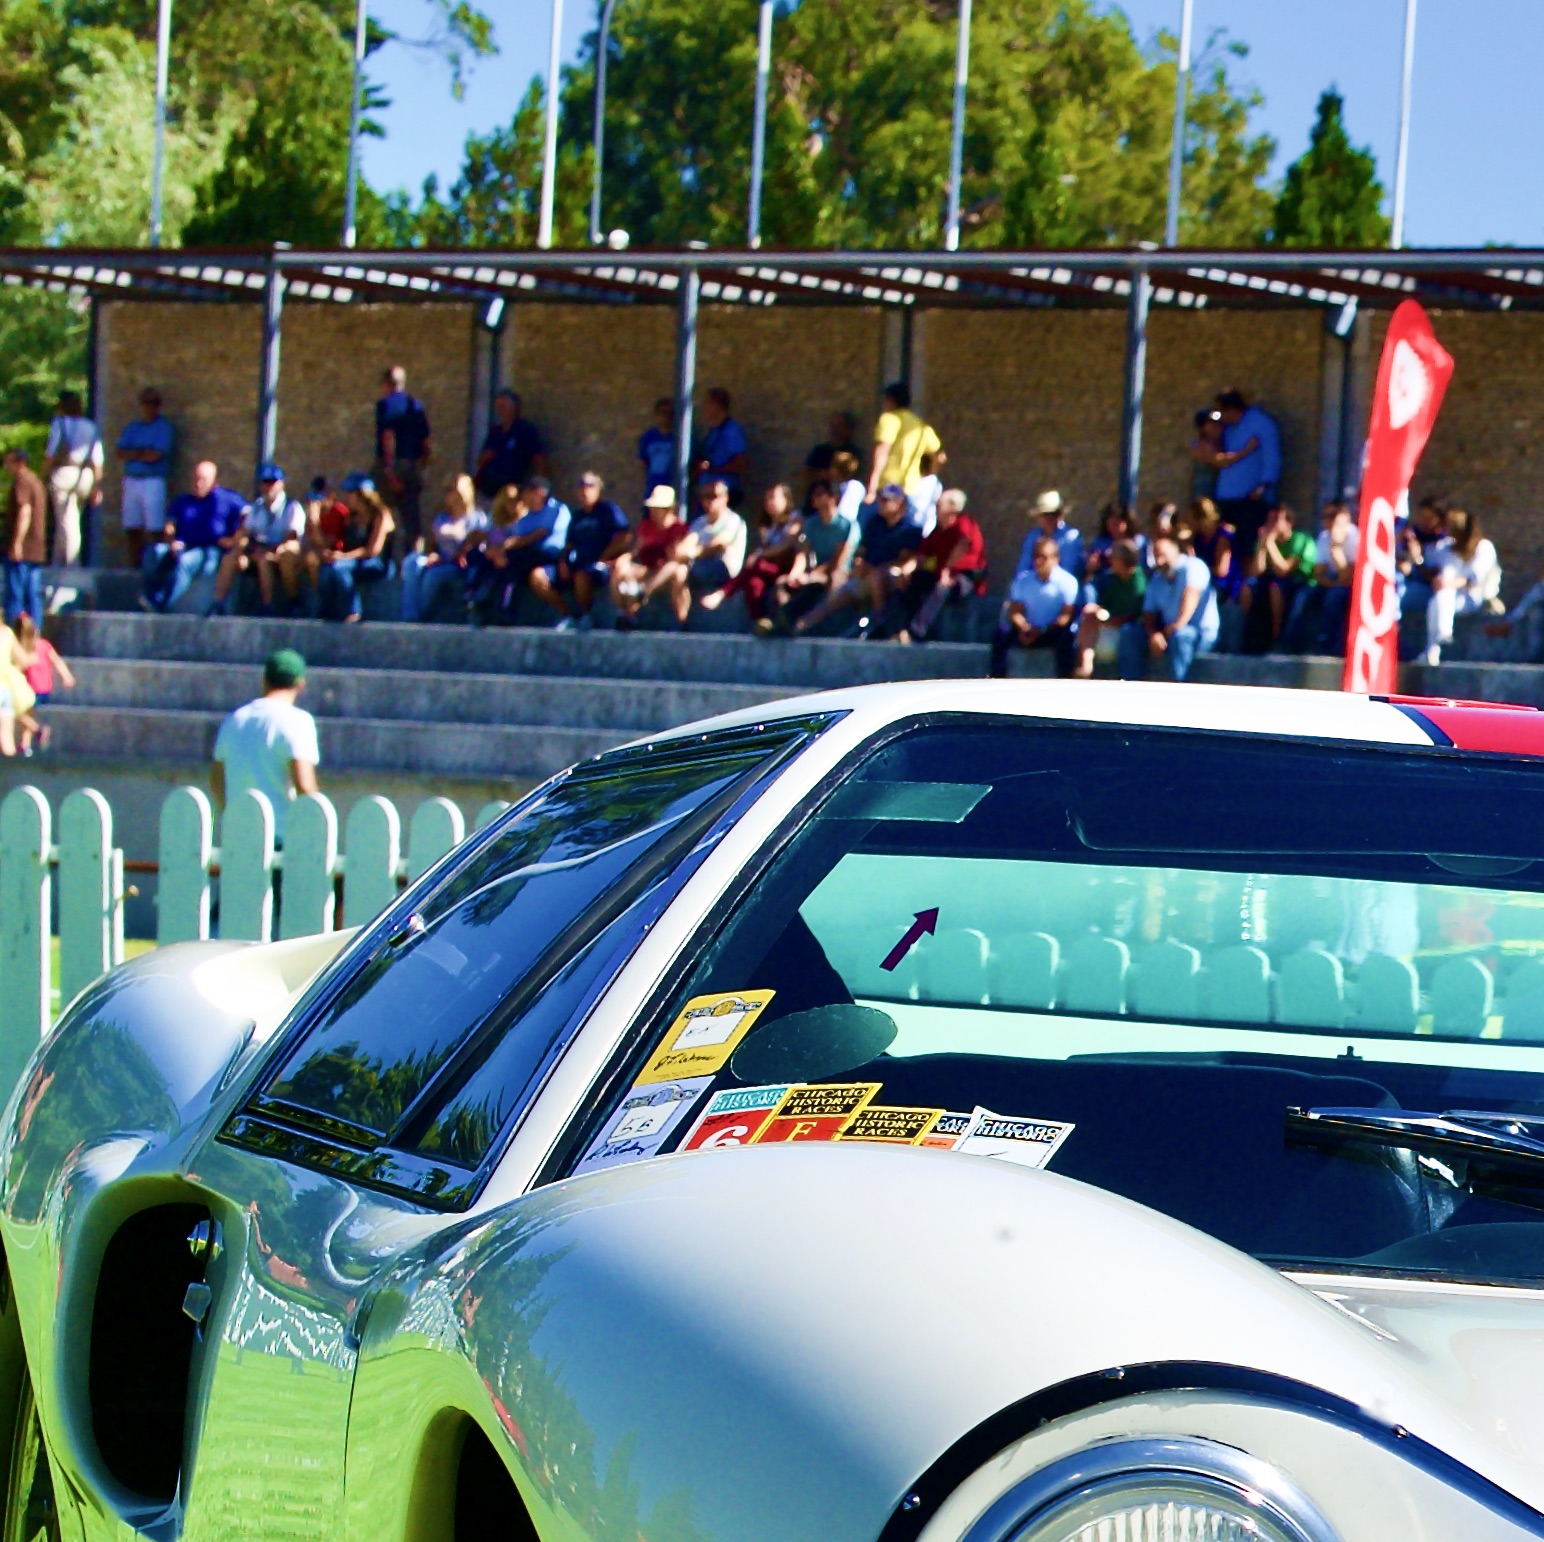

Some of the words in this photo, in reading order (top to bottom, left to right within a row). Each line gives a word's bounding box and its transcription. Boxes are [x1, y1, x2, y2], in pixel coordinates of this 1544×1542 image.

[792, 1088, 867, 1099] CHICAGO
[786, 1097, 861, 1107] HISTORIC
[791, 1105, 845, 1115] RACES
[786, 1121, 818, 1142] F
[853, 1127, 908, 1137] RACES
